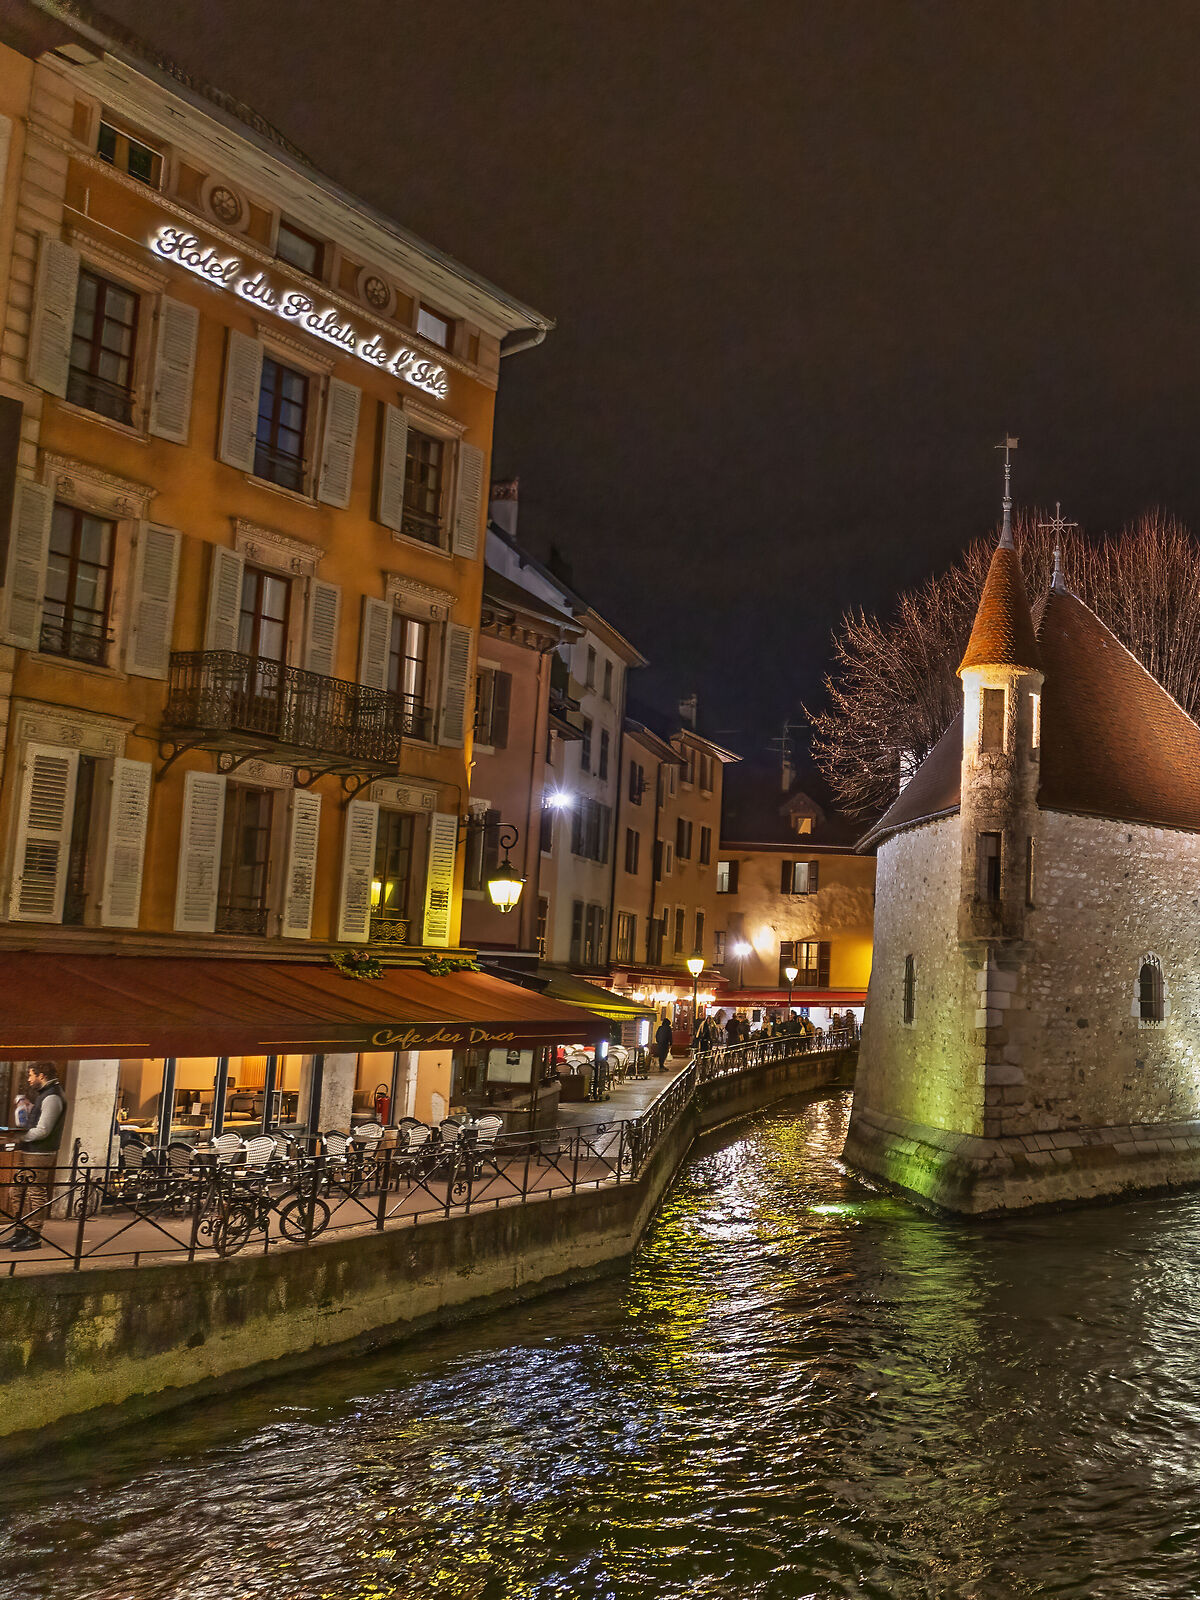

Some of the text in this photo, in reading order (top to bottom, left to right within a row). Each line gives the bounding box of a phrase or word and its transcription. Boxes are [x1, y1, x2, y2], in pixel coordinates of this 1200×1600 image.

[156, 227, 241, 284] Hotel
[242, 272, 278, 307] du
[283, 293, 357, 350] Palais
[361, 336, 388, 365] de
[424, 1026, 464, 1044] des
[468, 1026, 518, 1045] Ducs
